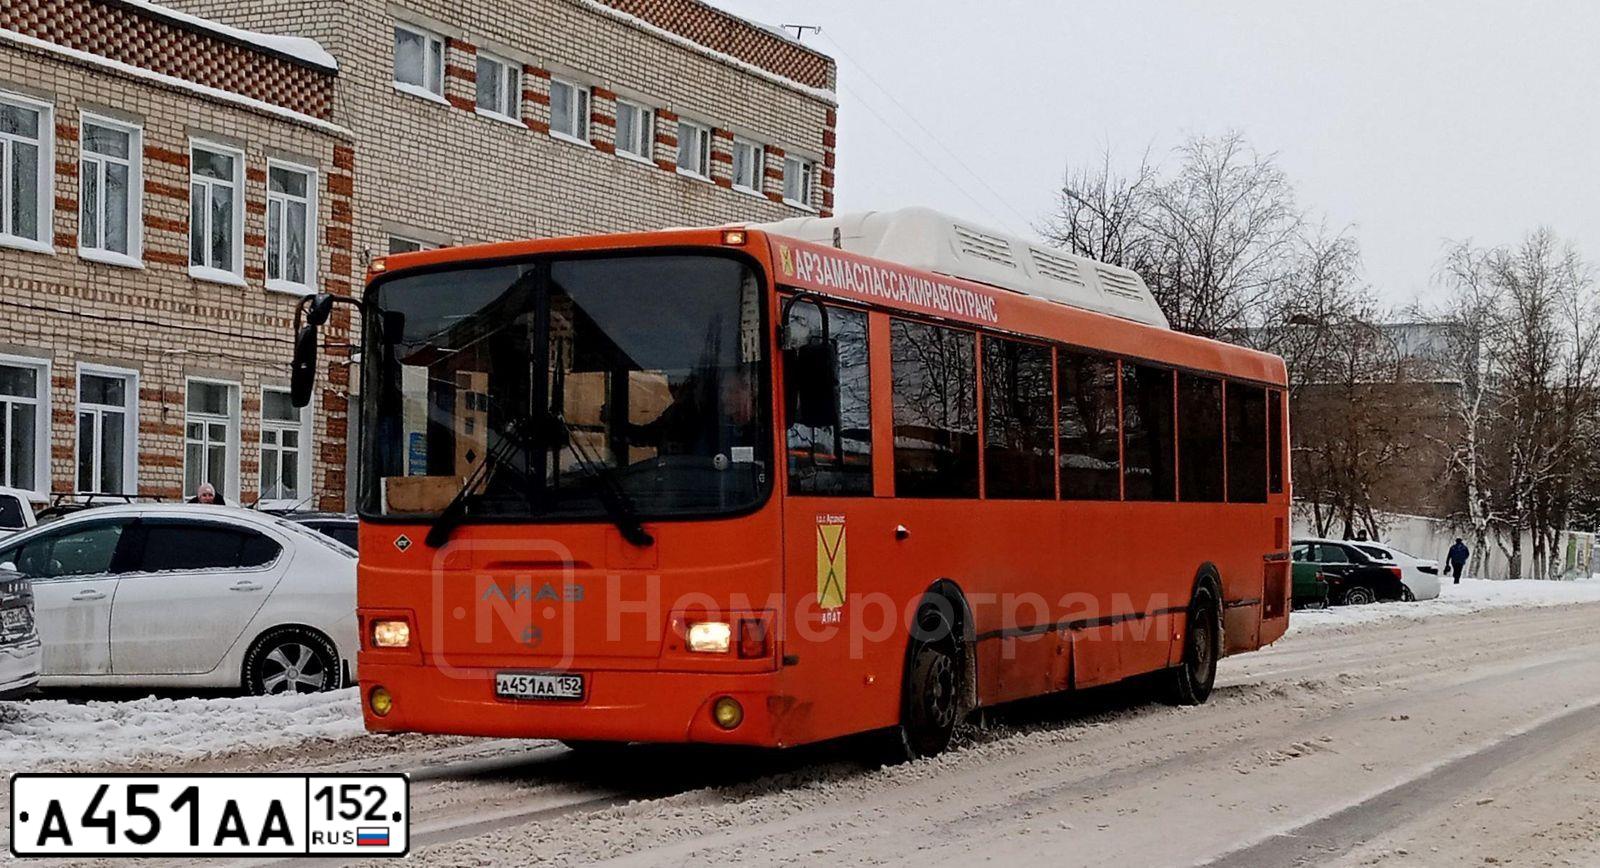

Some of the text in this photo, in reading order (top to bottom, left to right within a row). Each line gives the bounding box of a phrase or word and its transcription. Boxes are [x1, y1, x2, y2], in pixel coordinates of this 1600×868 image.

[795, 248, 998, 323] АРЗАМАСПАССАЖИРАВТОТРАНС
[501, 677, 580, 694] А451АА 152
